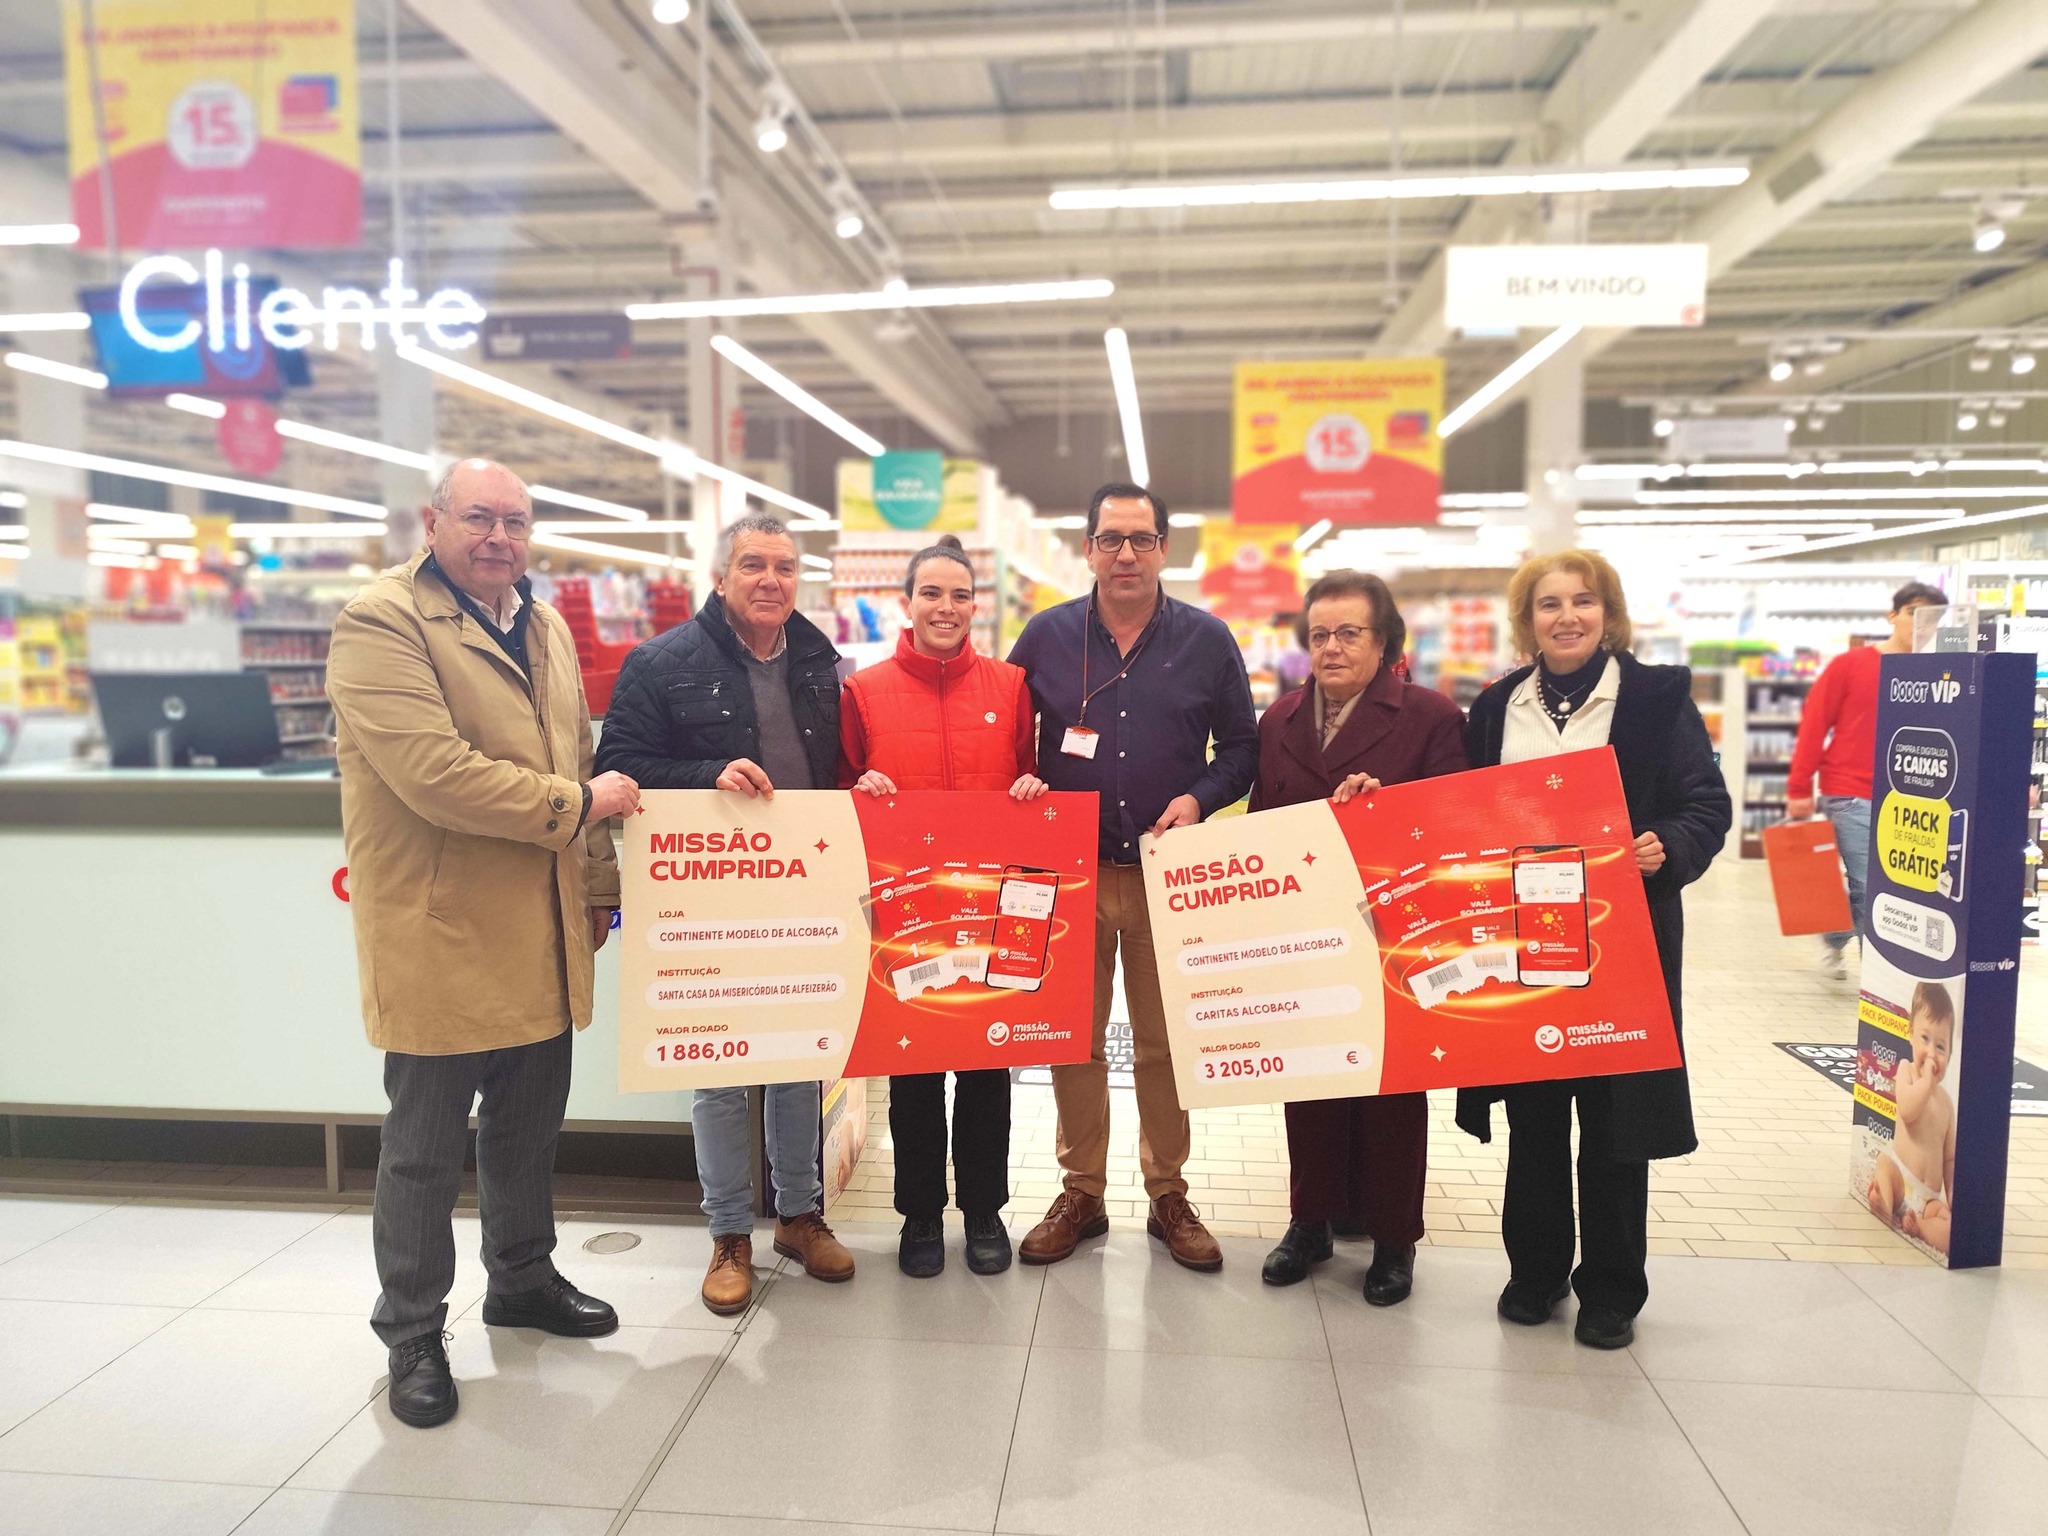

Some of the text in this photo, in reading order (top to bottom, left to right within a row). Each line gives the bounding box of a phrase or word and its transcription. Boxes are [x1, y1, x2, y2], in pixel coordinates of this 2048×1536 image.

[1506, 276, 1647, 297] BEM VINDO
[118, 248, 480, 353] Cliente
[1931, 678, 1961, 704] VIP
[1894, 755, 1948, 778] 2 CAIXAS
[1904, 775, 1935, 788] DE FRALDAS
[1893, 806, 1940, 834] 1 PACK
[650, 827, 772, 854] MISSÃO
[1894, 829, 1903, 840] DE
[1904, 832, 1936, 848] FRALDAS
[650, 859, 807, 881] CUMPRIDA
[1164, 853, 1264, 889] MISSÃO
[1889, 847, 1939, 880] GRÁTIS
[1168, 874, 1302, 912] CUMPRIDA
[659, 910, 685, 918] LOJA
[1460, 906, 1504, 917] SOLIDÁRIO
[1470, 900, 1492, 908] VALE
[902, 917, 921, 927] VALE
[950, 913, 987, 921] SOLIDÁRIO
[1407, 917, 1428, 930] VALE
[659, 926, 839, 942] CONTINENTE MODELO DE ALCOBAÇA
[894, 921, 933, 936] SOLIDÁRIO
[1401, 920, 1441, 941] SOLIDÁRIO
[1182, 936, 1203, 946] LOJA
[1187, 937, 1344, 967] CONTINENTE MODELO DE ALCOBAÇA
[657, 966, 721, 977] INSTITUIÇÃO
[658, 980, 837, 1000] SANTA CASA DA MISERICÓRDIA DE ALFEIZERÃO
[1191, 986, 1243, 1000] INSTITUIÇÃO
[1196, 1001, 1300, 1021] CARITAS ALCOBAÇA
[1862, 1005, 1877, 1019] PACK
[656, 1024, 729, 1035] VALOR DOADO
[657, 1037, 829, 1062] 1 886,00 €
[1200, 1041, 1261, 1054] VALOR DOADO
[1872, 1040, 1897, 1064] DODOT
[1205, 1051, 1359, 1079] 3 205,00 €
[1858, 1087, 1872, 1103] PACK
[1868, 1117, 1893, 1141] DODOT
